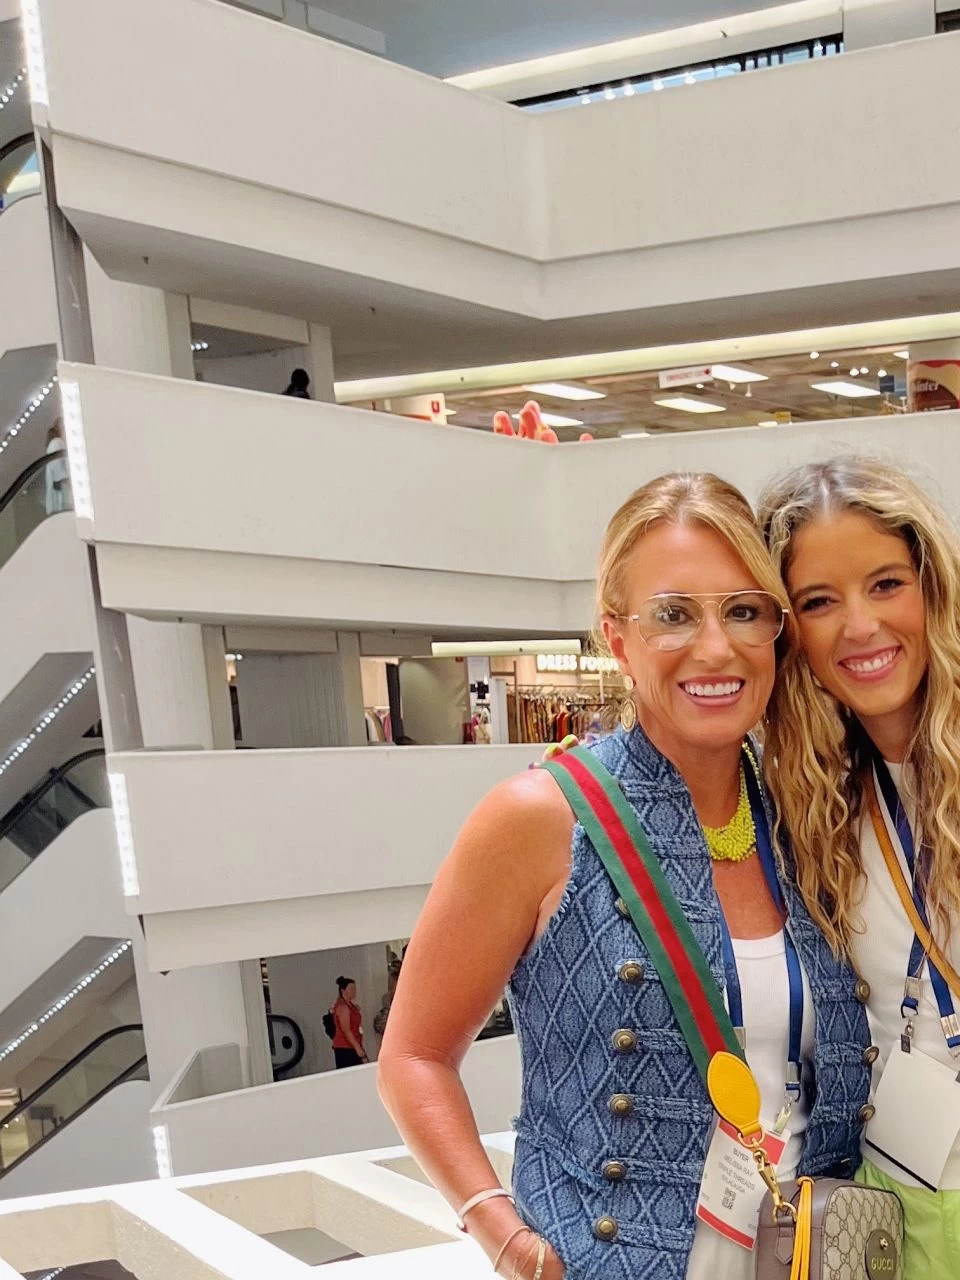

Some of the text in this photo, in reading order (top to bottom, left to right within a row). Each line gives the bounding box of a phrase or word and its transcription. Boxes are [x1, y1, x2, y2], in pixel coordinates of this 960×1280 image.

[537, 654, 577, 671] DRESS
[733, 1148, 749, 1162] BUYER
[871, 1257, 893, 1270] GUCCI
